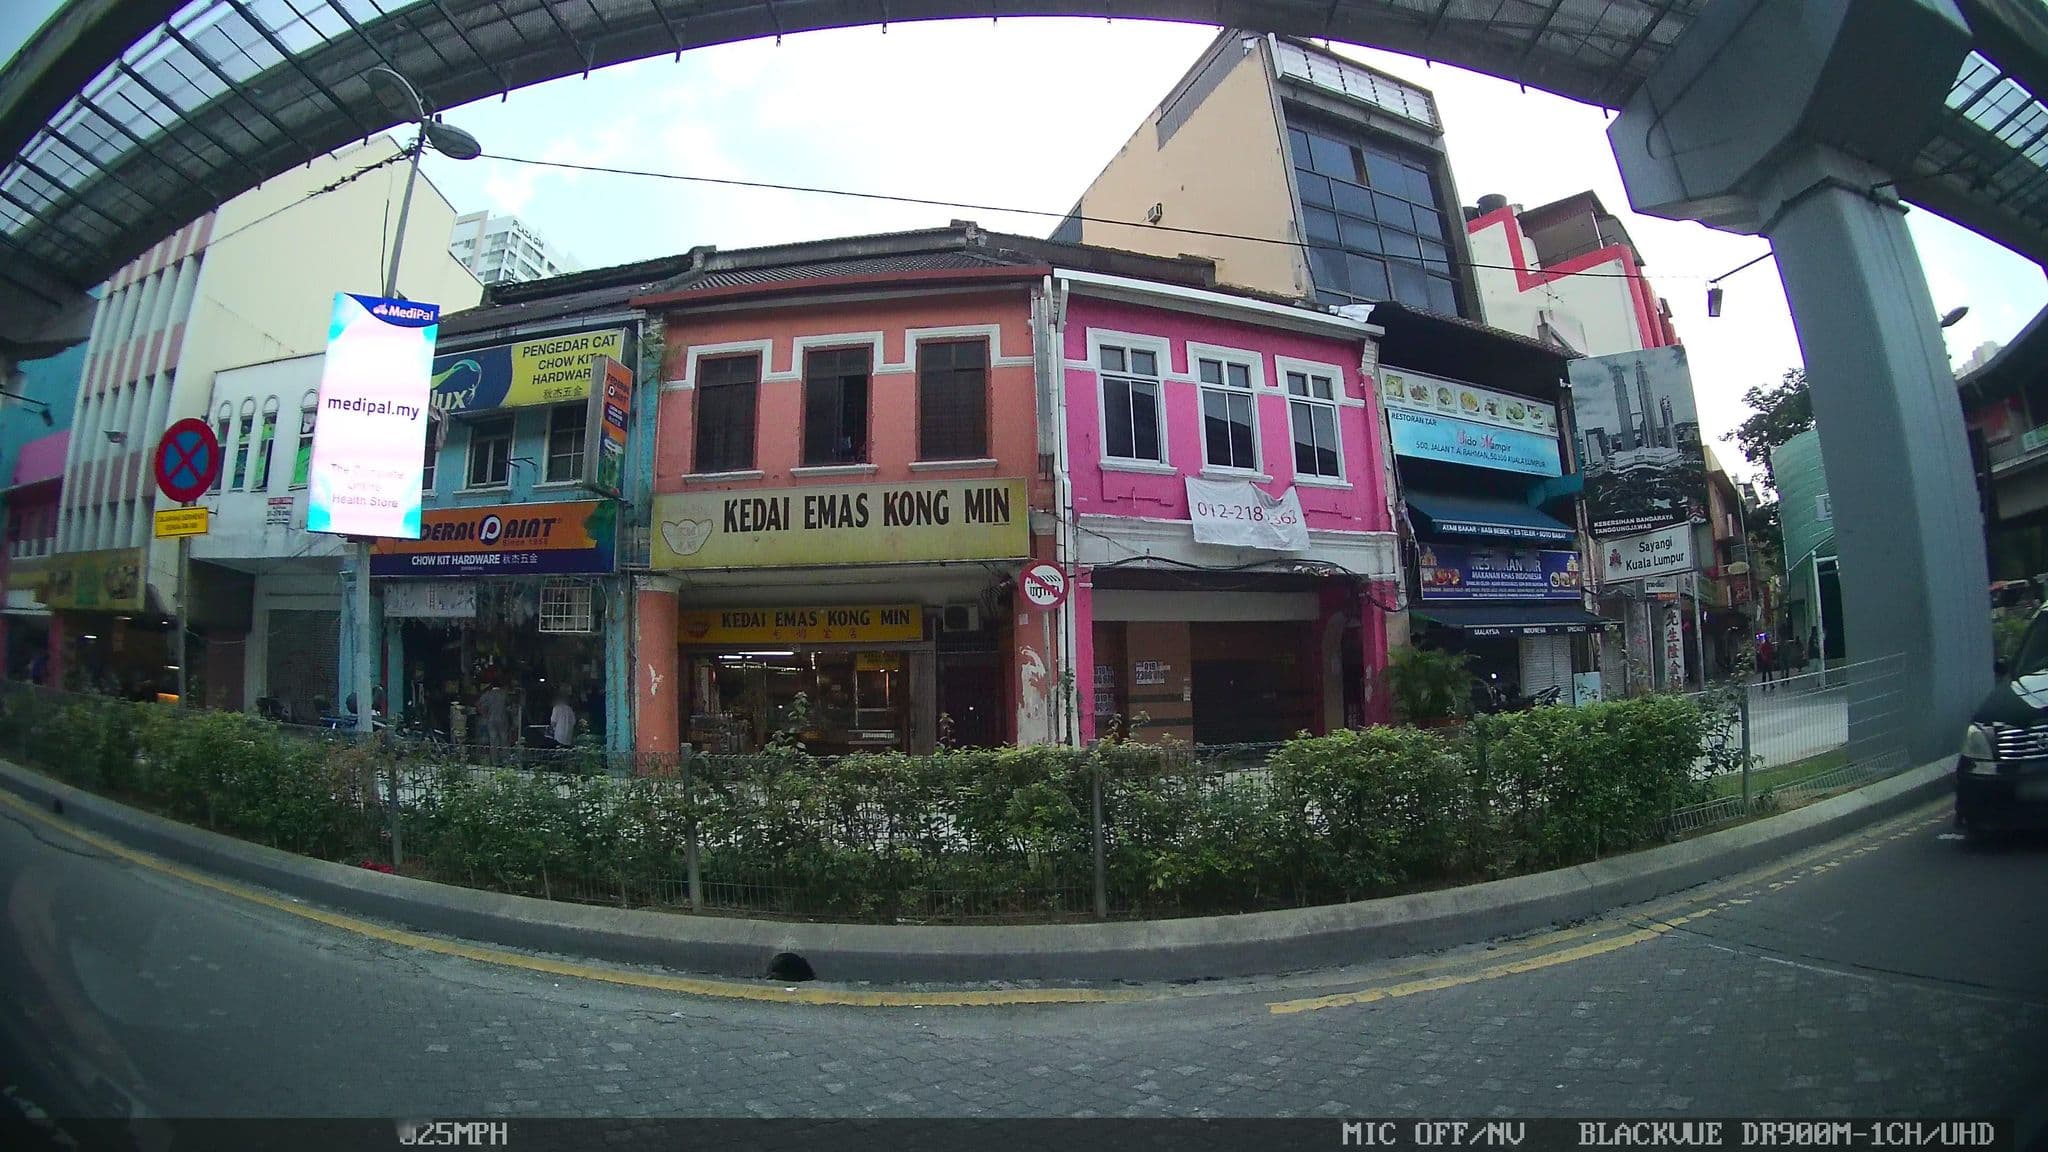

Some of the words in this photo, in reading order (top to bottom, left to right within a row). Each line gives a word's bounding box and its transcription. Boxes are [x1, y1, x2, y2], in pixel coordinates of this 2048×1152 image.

[388, 305, 434, 320] MediPal
[522, 337, 589, 358] PENGEDAR
[592, 334, 617, 349] CAT
[538, 355, 573, 370] CHOW
[577, 352, 597, 364] KIT
[532, 367, 592, 386] HARDWAR
[327, 397, 420, 421] medipal.my
[1391, 412, 1425, 424] RESTORAN
[332, 493, 366, 506] Health
[369, 496, 398, 508] Store
[723, 496, 790, 533] KEDAI
[804, 493, 869, 531] EMAS
[883, 489, 949, 527] KONG
[964, 487, 1010, 524] MIN
[421, 521, 473, 542] DERAL
[1594, 518, 1635, 528] KEBERSIHAN
[1639, 536, 1673, 553] Sayangi
[412, 555, 436, 566] CHOW
[436, 554, 450, 565] KIT
[452, 554, 500, 565] HARDWARE
[1626, 559, 1651, 571] Kuala
[1654, 552, 1685, 566] Lumpur
[720, 612, 766, 628] KEDAI
[775, 610, 818, 627] EMAS
[827, 609, 871, 626] KONG
[879, 608, 911, 625] MIN
